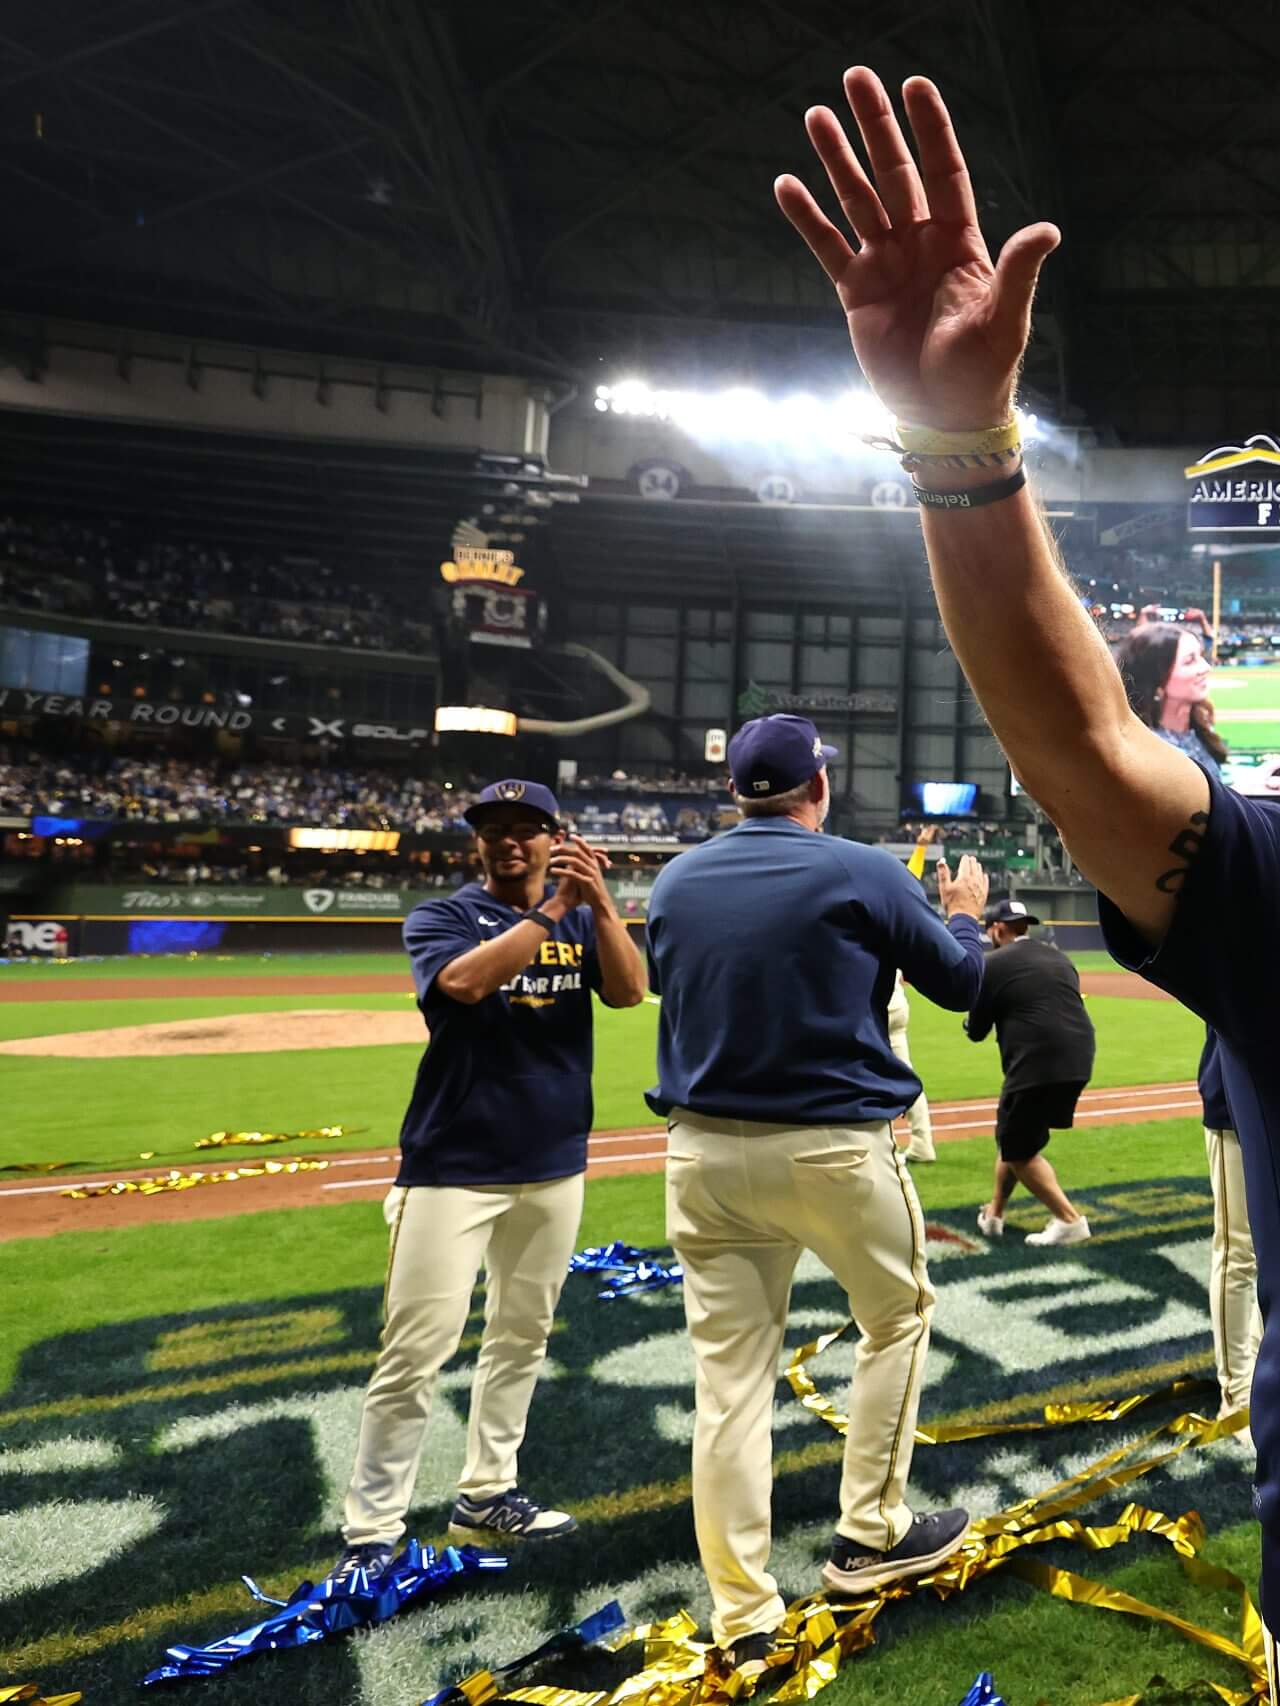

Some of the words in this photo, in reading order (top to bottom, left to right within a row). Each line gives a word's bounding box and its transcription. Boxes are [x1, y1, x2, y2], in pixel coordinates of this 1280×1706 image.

[24, 694, 113, 719] YEAR
[131, 703, 253, 730] ROUND
[552, 972, 582, 992] FAL
